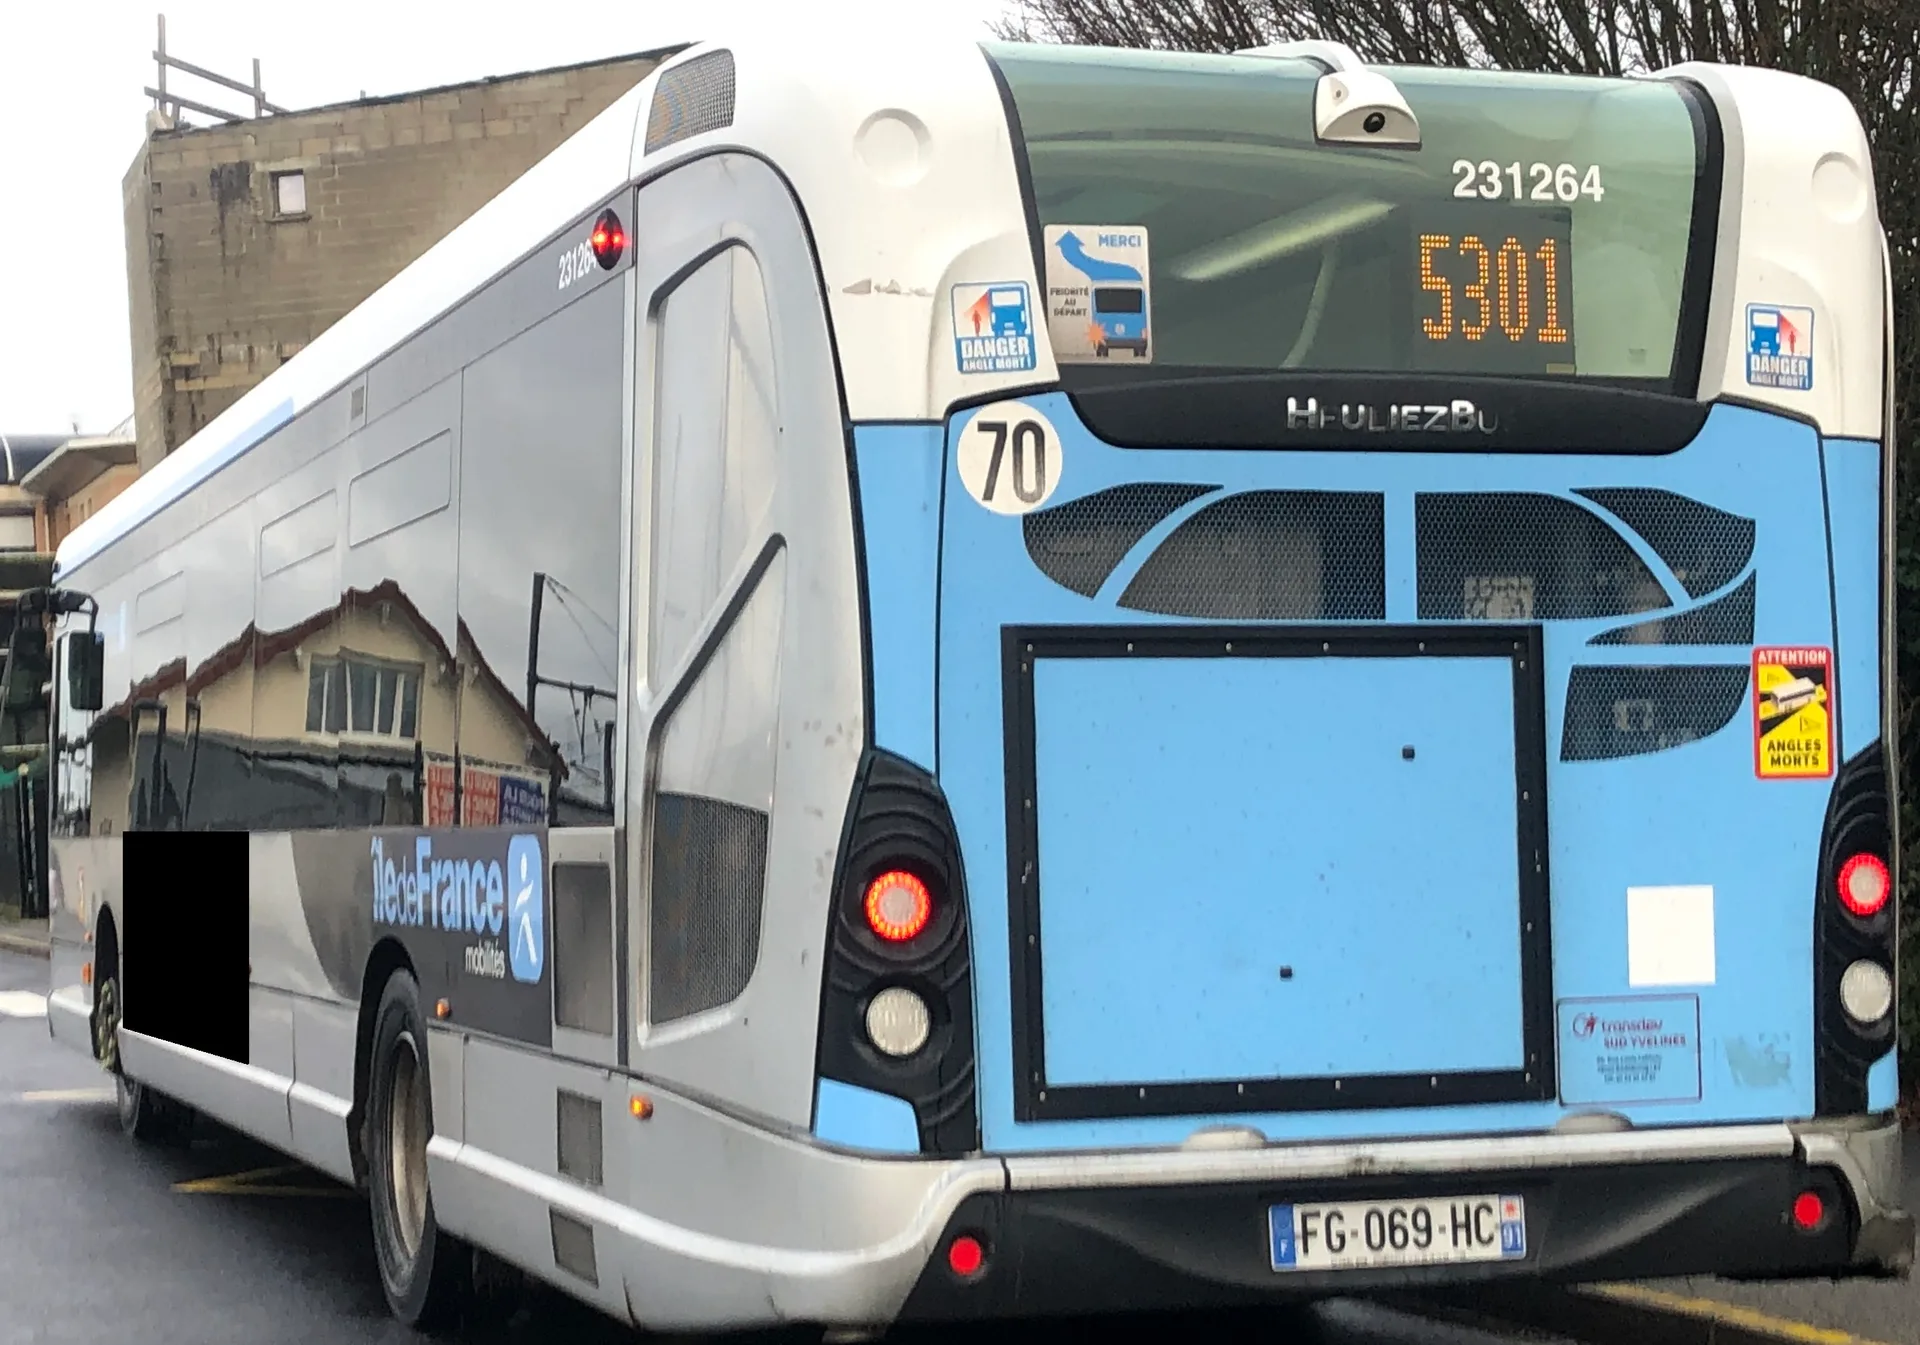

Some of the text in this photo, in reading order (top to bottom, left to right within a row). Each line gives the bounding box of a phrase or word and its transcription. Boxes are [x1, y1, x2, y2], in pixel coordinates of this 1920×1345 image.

[1452, 159, 1604, 202] 231264
[1098, 234, 1141, 247] MERCI
[1050, 286, 1089, 296] PRIORITÉ
[1420, 234, 1567, 342] 5301
[1064, 298, 1076, 306] AU
[1053, 306, 1087, 316] DÉPART
[961, 336, 1030, 359] DANGER
[963, 357, 994, 372] ANGLE
[1750, 353, 1808, 377] DANGER
[977, 419, 1046, 503] 70
[1757, 649, 1827, 665] ATTENTION
[1767, 738, 1822, 752] ANGLES
[1770, 753, 1819, 768] MORTS
[465, 937, 506, 979] mobilités
